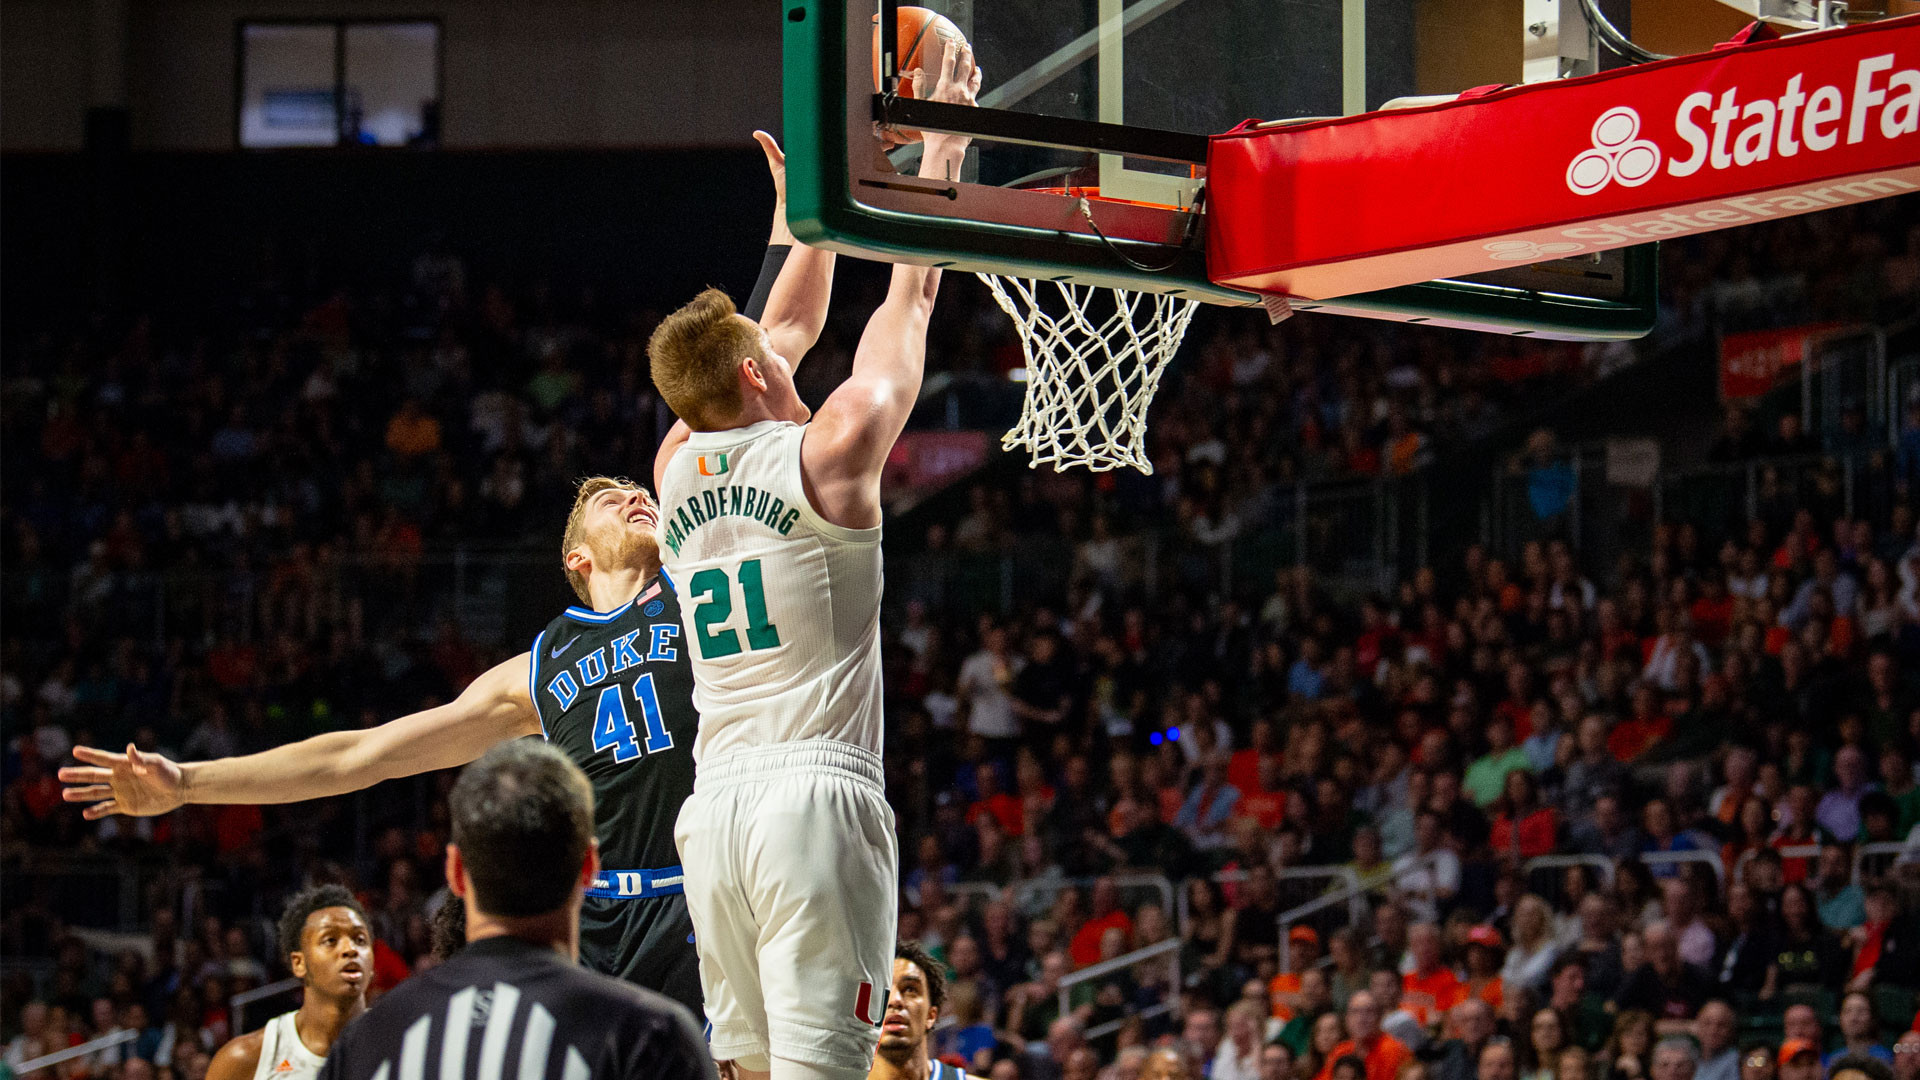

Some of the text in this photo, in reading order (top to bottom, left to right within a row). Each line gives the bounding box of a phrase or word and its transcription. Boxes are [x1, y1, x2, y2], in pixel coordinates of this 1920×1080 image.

[697, 453, 730, 477] U
[665, 485, 800, 558] WAARDENBURG
[689, 559, 782, 660] 21
[547, 623, 680, 712] DUKE
[591, 672, 675, 764] 41
[616, 872, 642, 896] D
